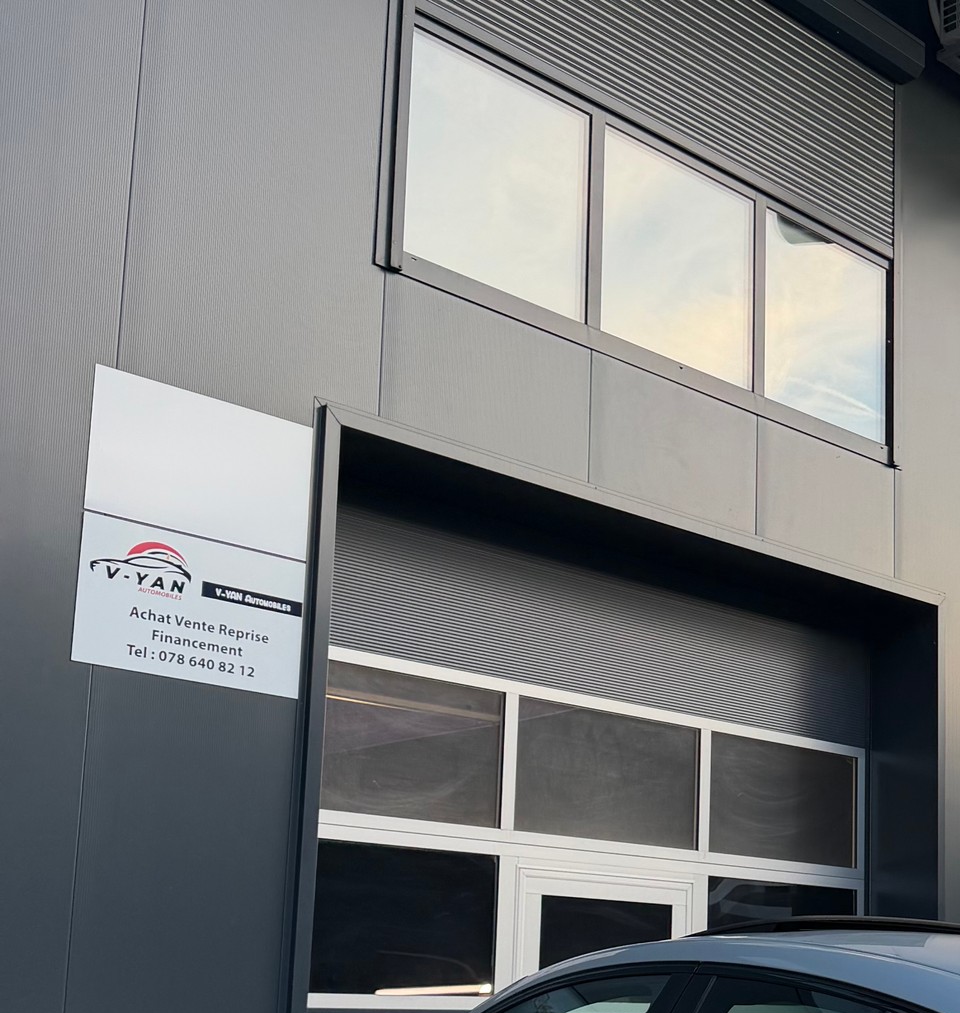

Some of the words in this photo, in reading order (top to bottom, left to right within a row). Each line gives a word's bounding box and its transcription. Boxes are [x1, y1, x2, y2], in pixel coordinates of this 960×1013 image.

[105, 565, 186, 594] V-YAN
[137, 587, 183, 601] AUTOMOBILES
[215, 587, 243, 602] V-YAN
[129, 606, 171, 625] Achat
[174, 615, 216, 633] Vente
[218, 624, 270, 645] Reprise
[151, 629, 243, 658] Financement
[126, 644, 147, 659] Tel
[158, 650, 185, 665] 078
[188, 655, 215, 670] 640
[218, 660, 235, 675] 82
[239, 665, 255, 678] 12
